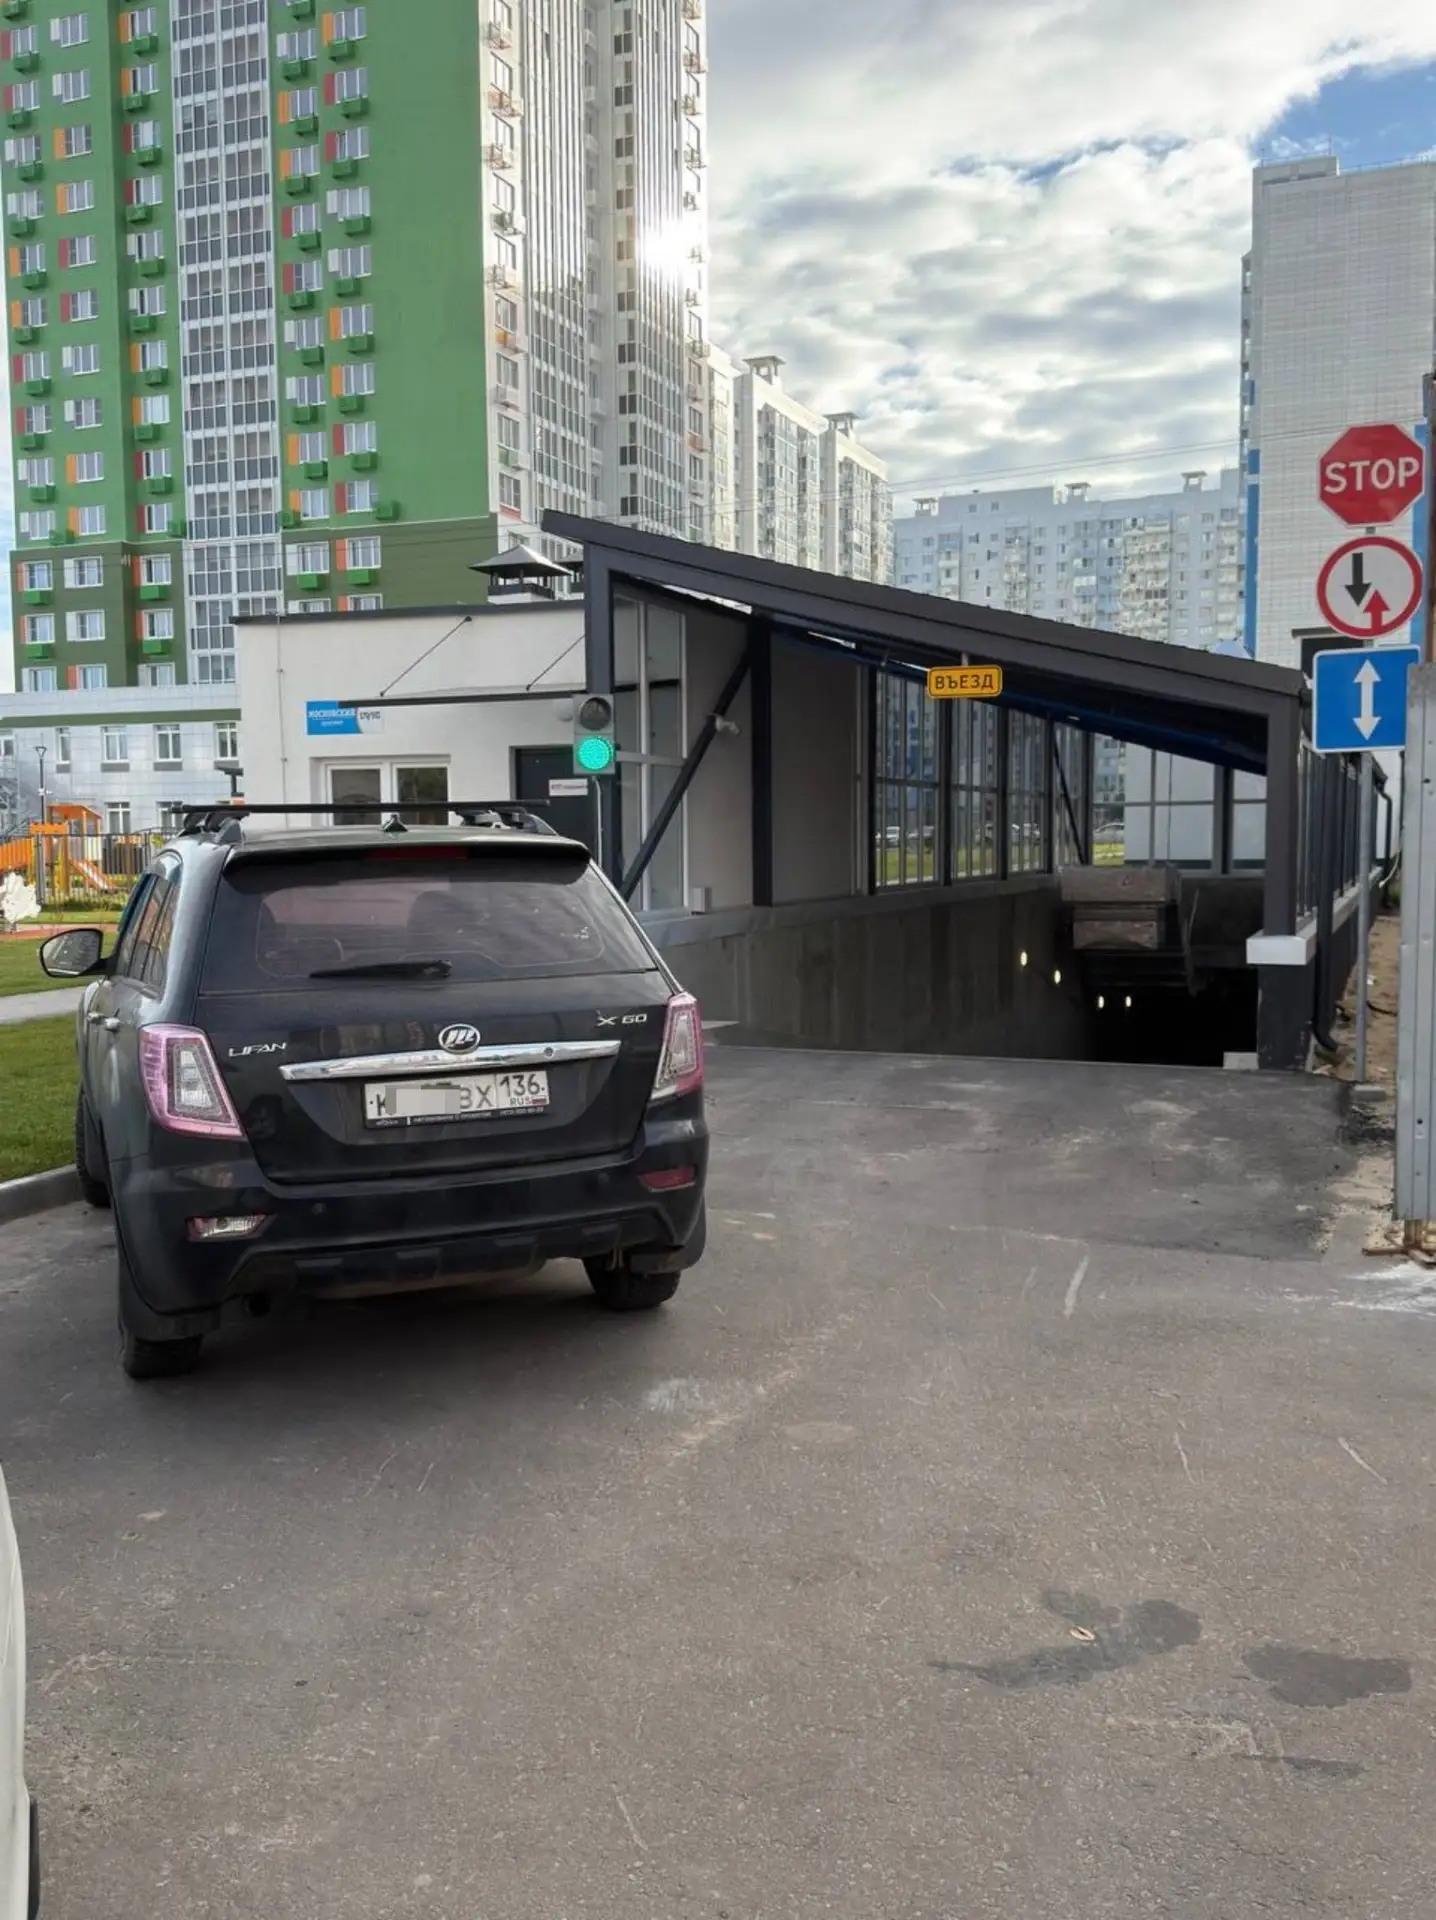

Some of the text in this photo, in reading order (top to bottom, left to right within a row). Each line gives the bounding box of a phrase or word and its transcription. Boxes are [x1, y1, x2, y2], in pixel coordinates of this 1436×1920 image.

[1324, 456, 1420, 493] STOP
[935, 674, 994, 690] ВЪЕЗД
[228, 1042, 287, 1057] LIFAN
[500, 1073, 540, 1097] 136
[510, 1097, 533, 1106] RUS
